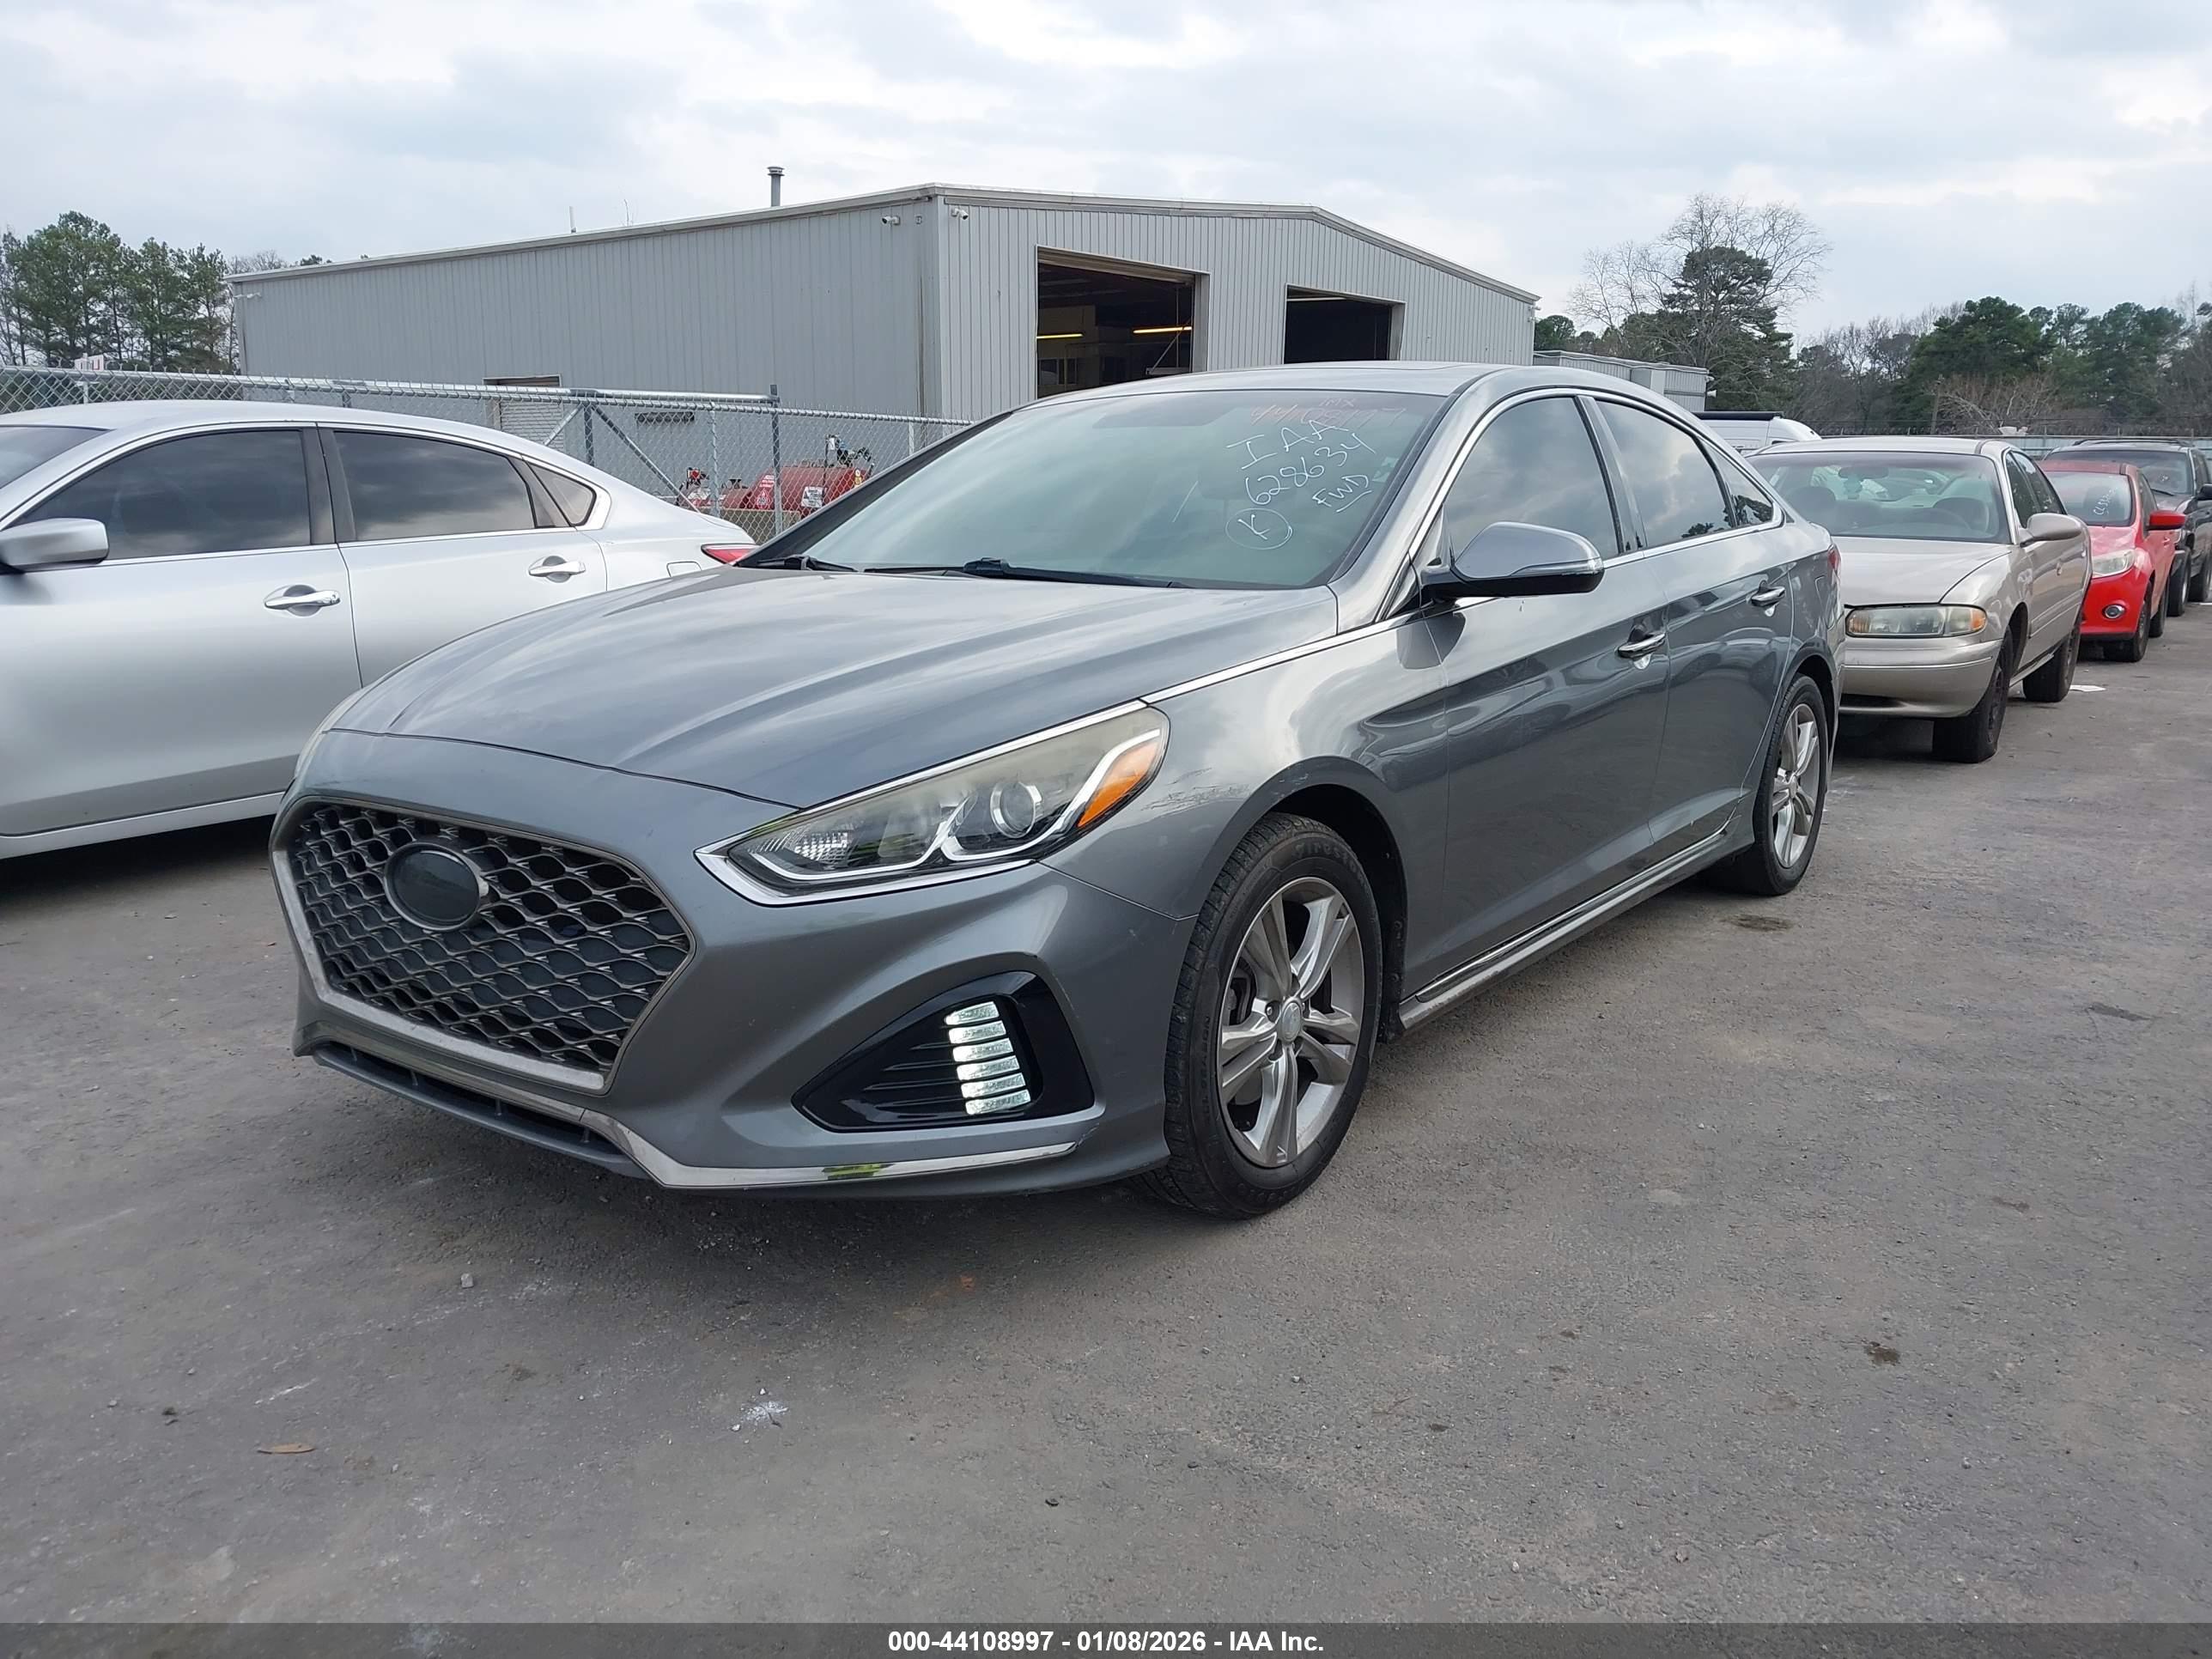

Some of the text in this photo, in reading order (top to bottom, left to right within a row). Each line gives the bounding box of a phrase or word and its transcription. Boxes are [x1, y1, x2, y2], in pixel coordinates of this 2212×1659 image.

[1225, 419, 1350, 470] IAA
[1245, 432, 1376, 505] 628634
[1311, 474, 1369, 507] FWD
